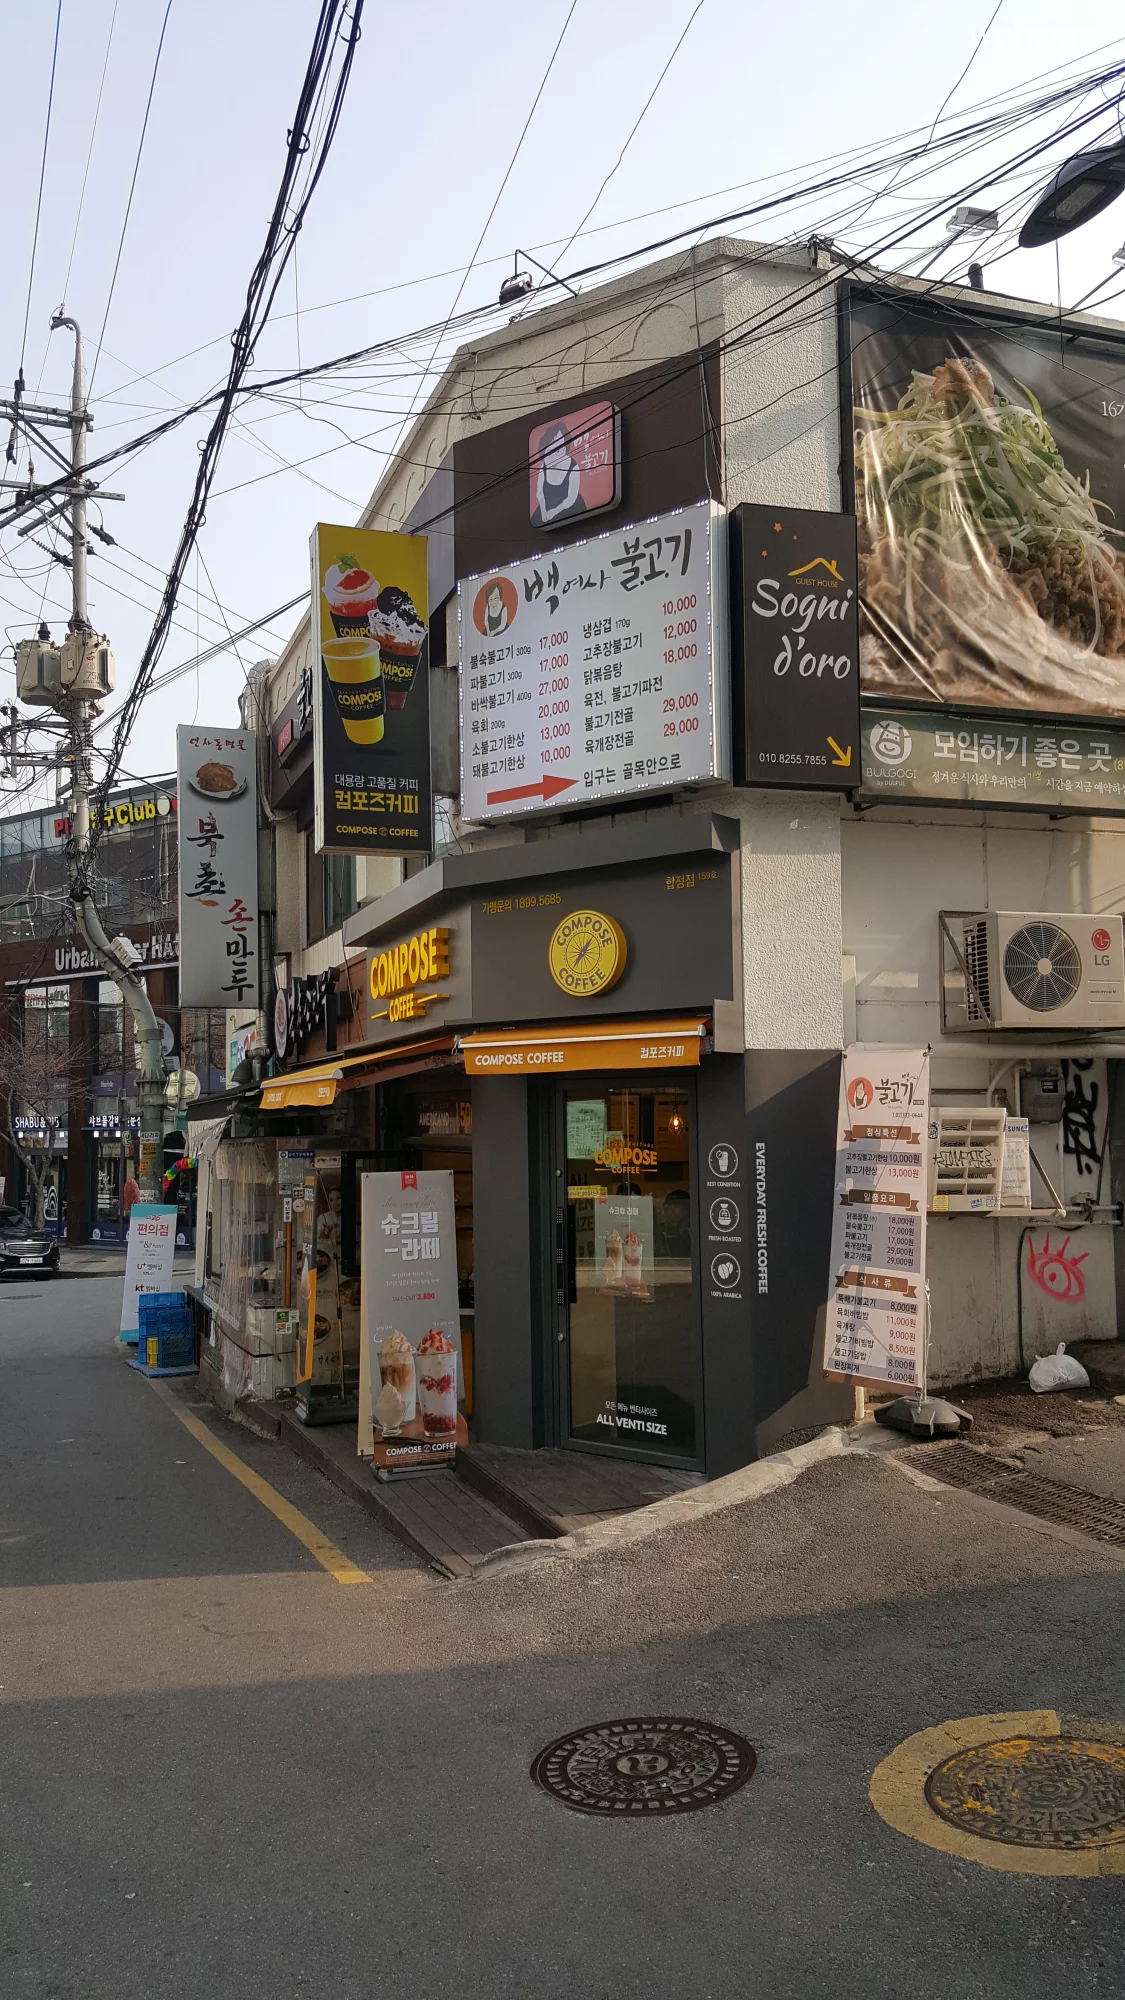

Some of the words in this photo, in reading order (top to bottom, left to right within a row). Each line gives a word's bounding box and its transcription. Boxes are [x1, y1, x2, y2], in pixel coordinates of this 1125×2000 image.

[581, 450, 608, 472] 불고기
[611, 529, 692, 592] 불고기
[795, 578, 815, 587] GUEST
[817, 580, 838, 588] HOUSE
[752, 579, 853, 632] Sogni
[583, 618, 612, 639] 냉삼겹
[615, 619, 630, 630] 170g
[662, 595, 696, 616] 10,000
[516, 647, 531, 657] 300g
[539, 631, 568, 650] 17,000
[583, 634, 643, 661] 고추장불고기
[663, 619, 697, 640] 12,000
[583, 663, 623, 685] 닭볶음탕
[663, 644, 697, 664] 18,000
[773, 635, 850, 679] d'oro
[470, 670, 505, 691] 파불고기
[508, 671, 522, 682] 300g
[539, 654, 568, 672] 17,000
[338, 691, 381, 706] COMPOSE
[471, 691, 514, 712] 바싹불고기
[516, 691, 531, 702] 400g
[539, 677, 569, 695] 27,000
[584, 689, 607, 708] 육전,
[612, 676, 663, 702] 불고기파전
[471, 718, 489, 733] 육회
[490, 720, 505, 729] 200g
[538, 700, 569, 718] 20,000
[584, 707, 634, 732] 불고기전골
[663, 693, 698, 713] 29,000
[472, 733, 524, 756] 소불고기한상
[540, 723, 570, 741] 13,000
[585, 731, 634, 754] 육개장전골
[663, 718, 698, 737] 29,000
[540, 746, 570, 764] 10,000
[759, 752, 827, 765] 010.8255.7855
[933, 731, 1026, 766] 모임하기
[1033, 737, 1082, 769] 좋은
[1087, 742, 1112, 772] 곳
[584, 767, 616, 787] 입구는
[622, 754, 681, 779] 골목안으로
[867, 768, 916, 778] BULGOGI
[335, 774, 365, 787] 대용량
[367, 776, 397, 789] 고품질
[399, 778, 418, 791] 커피
[931, 771, 958, 784] 정겨운
[960, 773, 988, 786] 식사와
[990, 776, 1026, 789] 우리만의
[1046, 778, 1072, 792] 시간을
[1075, 781, 1092, 793] 지금
[335, 791, 418, 814] 컴포즈커피
[336, 825, 377, 835] COMPOSE
[389, 827, 418, 837] COFFEE
[666, 874, 696, 890] 합정점
[514, 892, 561, 910] 1899.5685
[556, 916, 613, 947] COMPOSE
[221, 899, 254, 1001] 손만두
[370, 928, 443, 999] COMPOSE
[1095, 955, 1109, 966] LG
[558, 968, 606, 991] COFFEE
[389, 992, 419, 1023] COFFEE
[475, 1053, 523, 1065] COMPOSE
[527, 1052, 564, 1064] COFFEE
[640, 1046, 684, 1058] 컴포즈커피
[875, 1078, 913, 1105] 불고기
[15, 1117, 39, 1128] SHABU
[595, 1148, 657, 1165] COMPOSE
[890, 1154, 920, 1163] 10,000원
[756, 1143, 766, 1207] EVERYDAY
[845, 1165, 878, 1175] 불고기한상
[889, 1169, 919, 1178] 13,000원
[863, 1193, 895, 1203] 일품요리
[137, 1224, 169, 1236] 편의점
[381, 1212, 439, 1235] 슈크림
[757, 1209, 767, 1247] FRESH
[889, 1217, 914, 1226] 18,000원
[845, 1232, 867, 1241] 파불고기
[888, 1237, 914, 1246] 17,000원
[888, 1227, 914, 1236] 17,000원
[887, 1247, 913, 1256] 29,000원
[887, 1257, 913, 1266] 29,000원
[758, 1249, 768, 1294] COFFEE
[860, 1276, 891, 1288] 식사류
[891, 1302, 916, 1313] 8,000원
[887, 1316, 916, 1328] 11,000원
[890, 1330, 915, 1342] 9,000원
[889, 1344, 915, 1355] 8,500원
[888, 1359, 915, 1370] 8,000원
[888, 1371, 914, 1383] 6,000원
[605, 1401, 616, 1410] 모든
[618, 1403, 628, 1412] 메뉴
[630, 1405, 657, 1416] 벤티사이즈
[597, 1414, 614, 1425] ALL
[616, 1417, 645, 1431] VENTI
[646, 1422, 667, 1435] SIZE
[386, 1446, 422, 1455] COMPOSE
